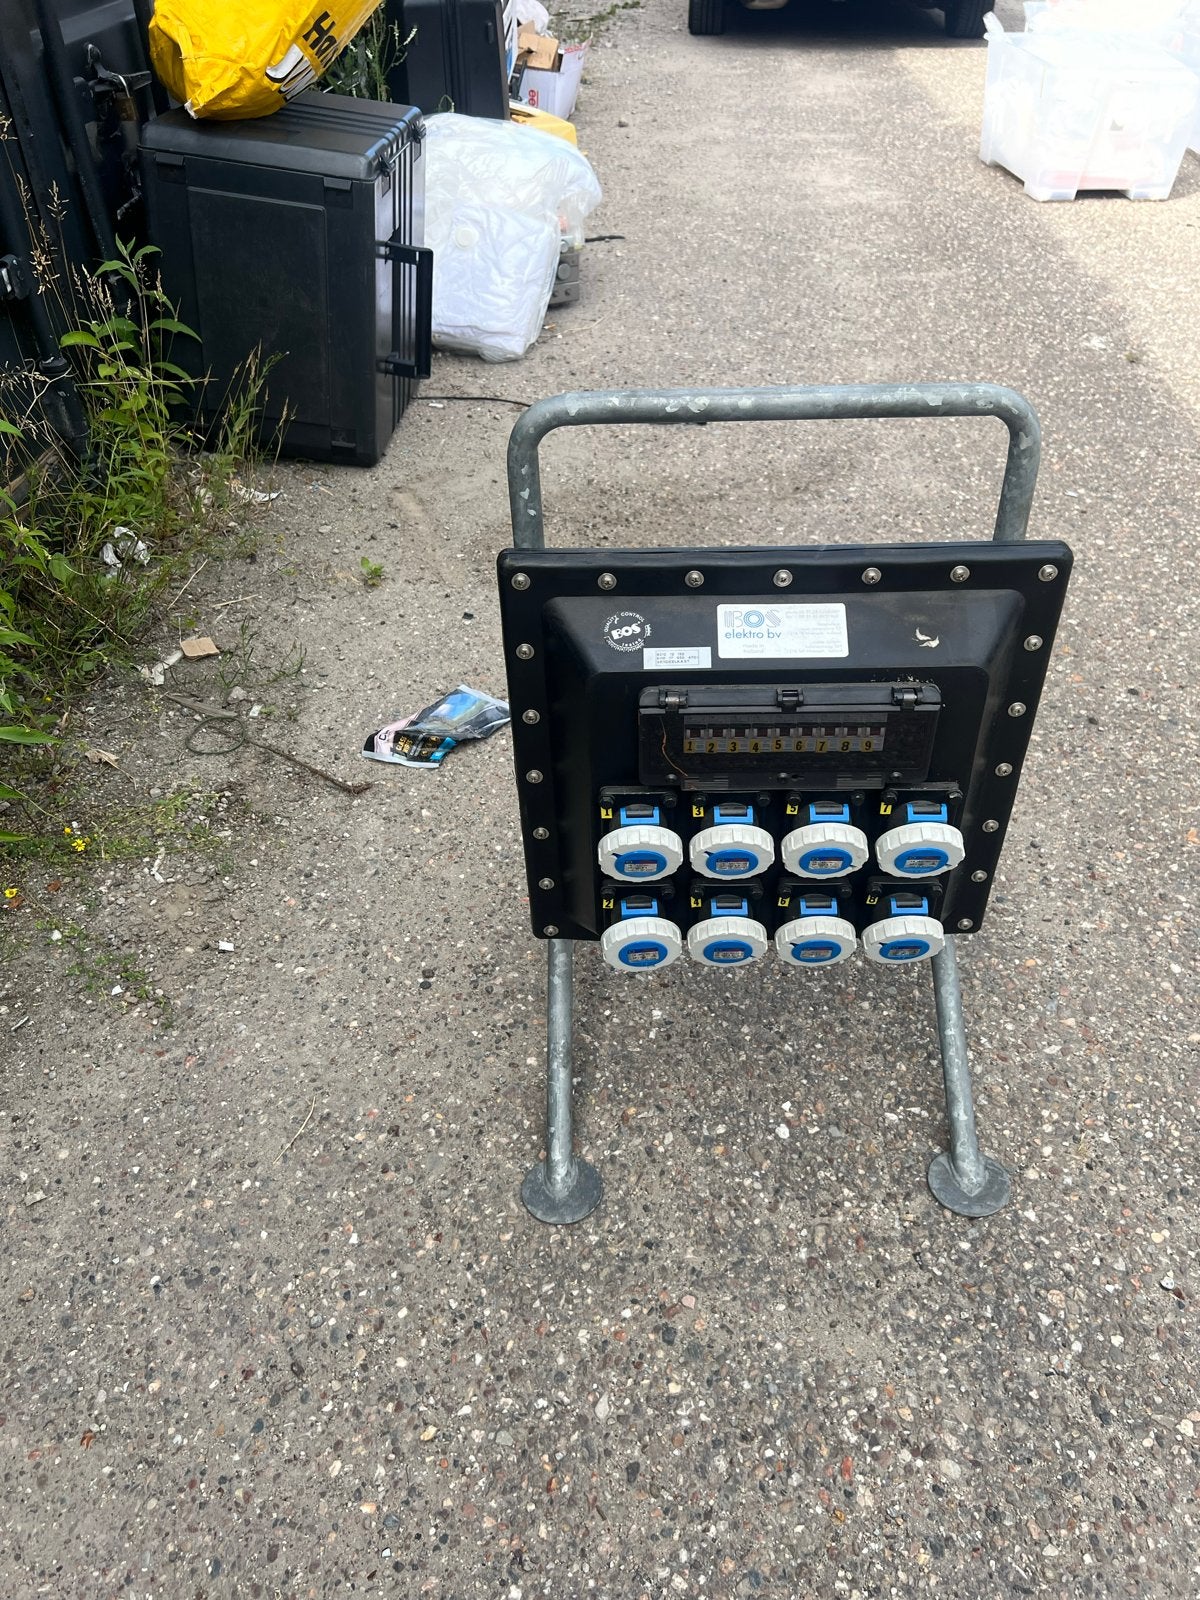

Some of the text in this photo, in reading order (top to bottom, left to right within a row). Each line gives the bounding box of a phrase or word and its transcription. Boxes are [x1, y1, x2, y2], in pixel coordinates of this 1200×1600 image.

[611, 622, 641, 640] BOS
[724, 629, 764, 639] elektro
[767, 628, 782, 639] bv
[686, 740, 872, 753] 1 2 3 4 5 6 7 8 9
